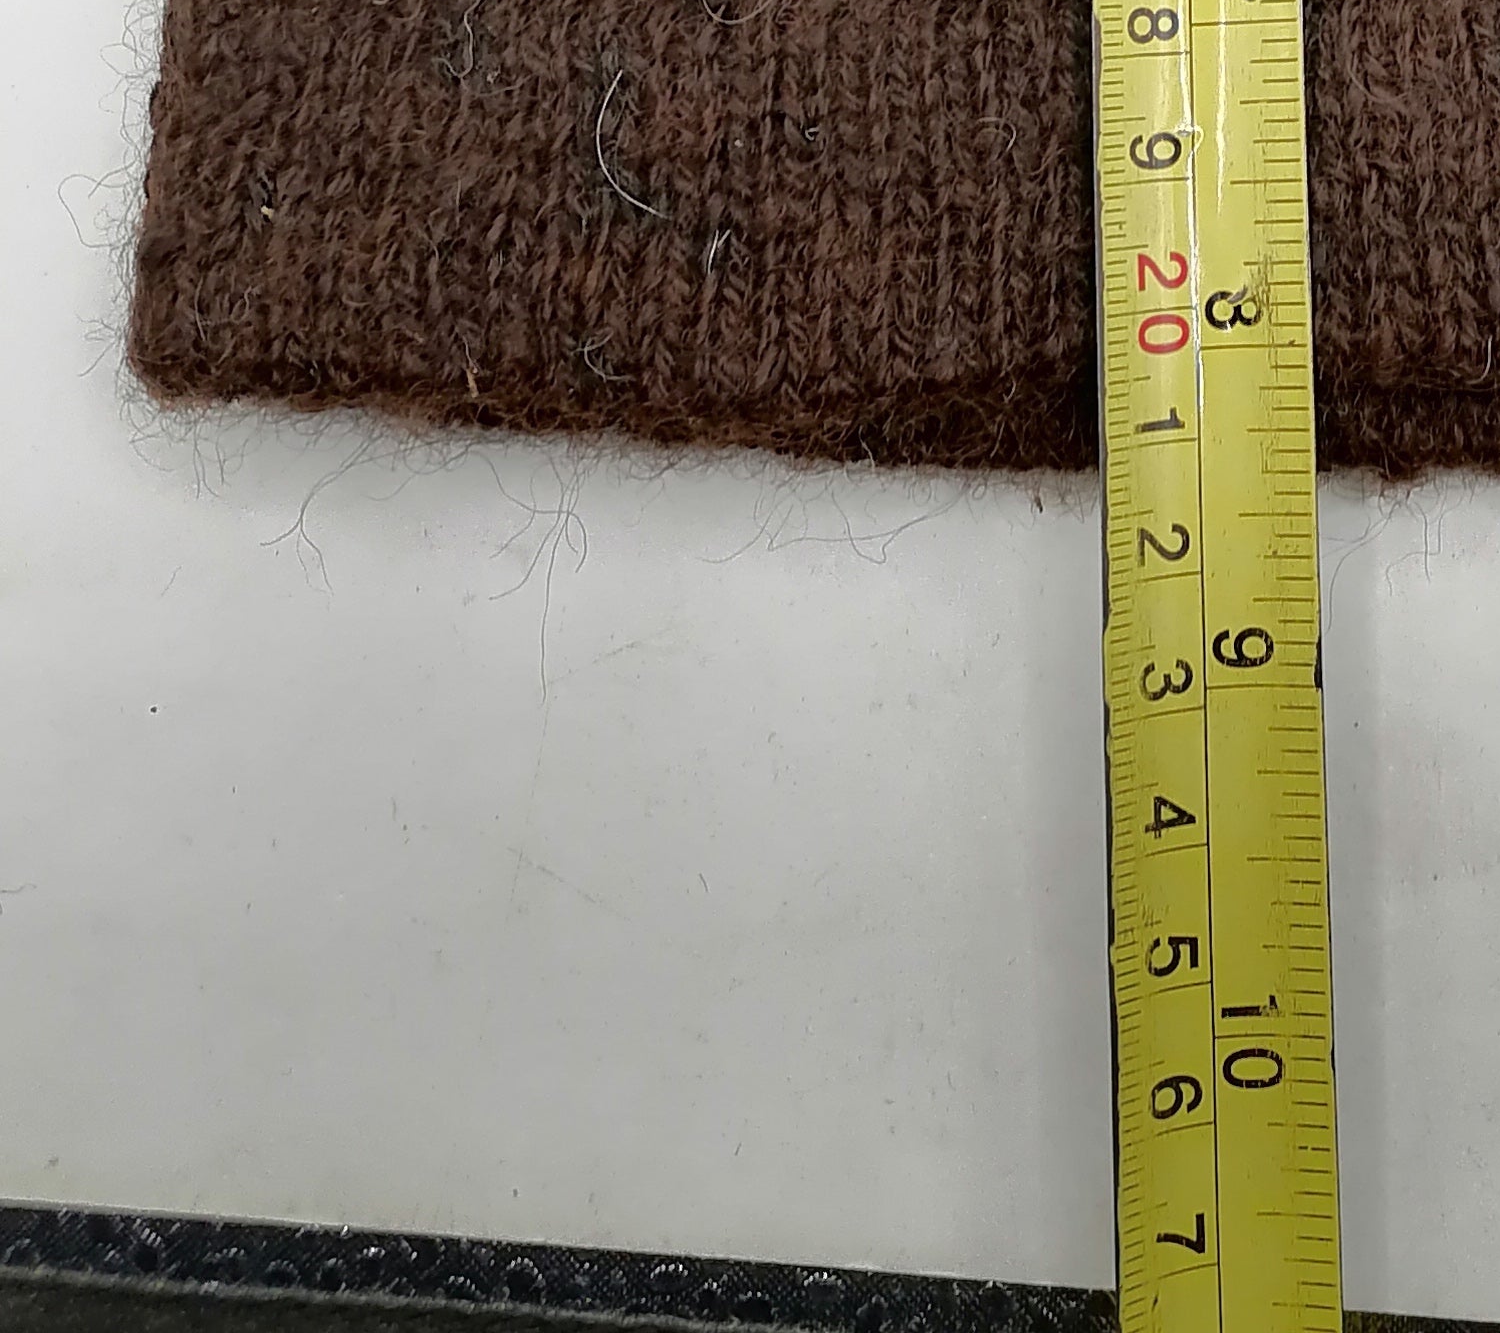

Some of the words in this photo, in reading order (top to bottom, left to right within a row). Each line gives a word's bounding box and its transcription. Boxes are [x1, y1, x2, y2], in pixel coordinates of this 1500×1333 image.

[1127, 7, 1179, 44] 8
[1129, 132, 1181, 170] 9
[1137, 251, 1190, 355] 20
[1205, 289, 1261, 331] 8
[1135, 407, 1185, 434] 1
[1136, 523, 1190, 566] 2
[1212, 627, 1274, 668] 9
[1140, 659, 1194, 703] 3
[1145, 796, 1197, 839] 4
[1145, 935, 1199, 977] 5
[1221, 994, 1284, 1089] 10
[1150, 1074, 1203, 1120] 6
[1156, 1212, 1206, 1254] 7
